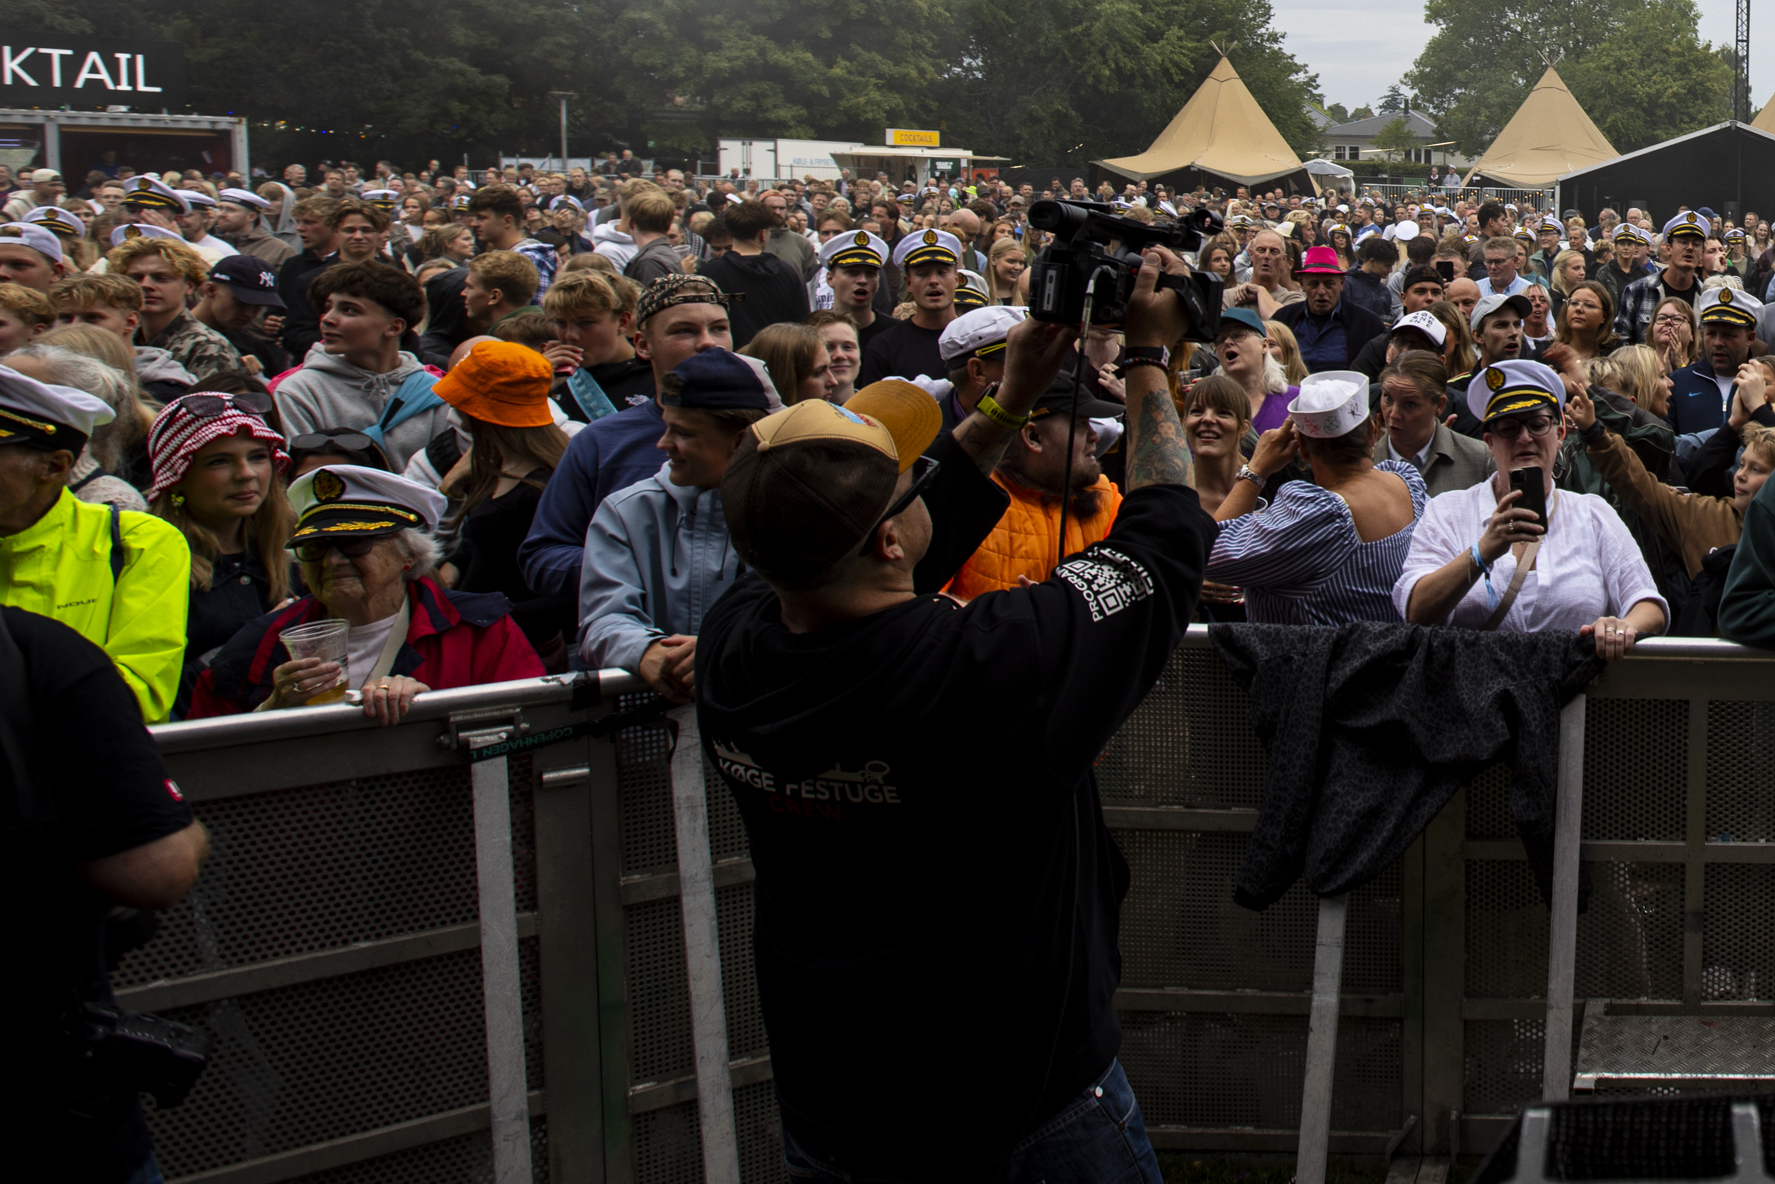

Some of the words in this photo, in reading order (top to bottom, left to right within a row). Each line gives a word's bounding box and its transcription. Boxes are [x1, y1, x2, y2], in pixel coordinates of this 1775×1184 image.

[2, 45, 163, 93] KTAIL
[899, 133, 933, 143] COCKTAILS
[483, 727, 573, 757] COPENHAGEN
[718, 757, 777, 793] KØGE
[767, 794, 842, 822] CREW
